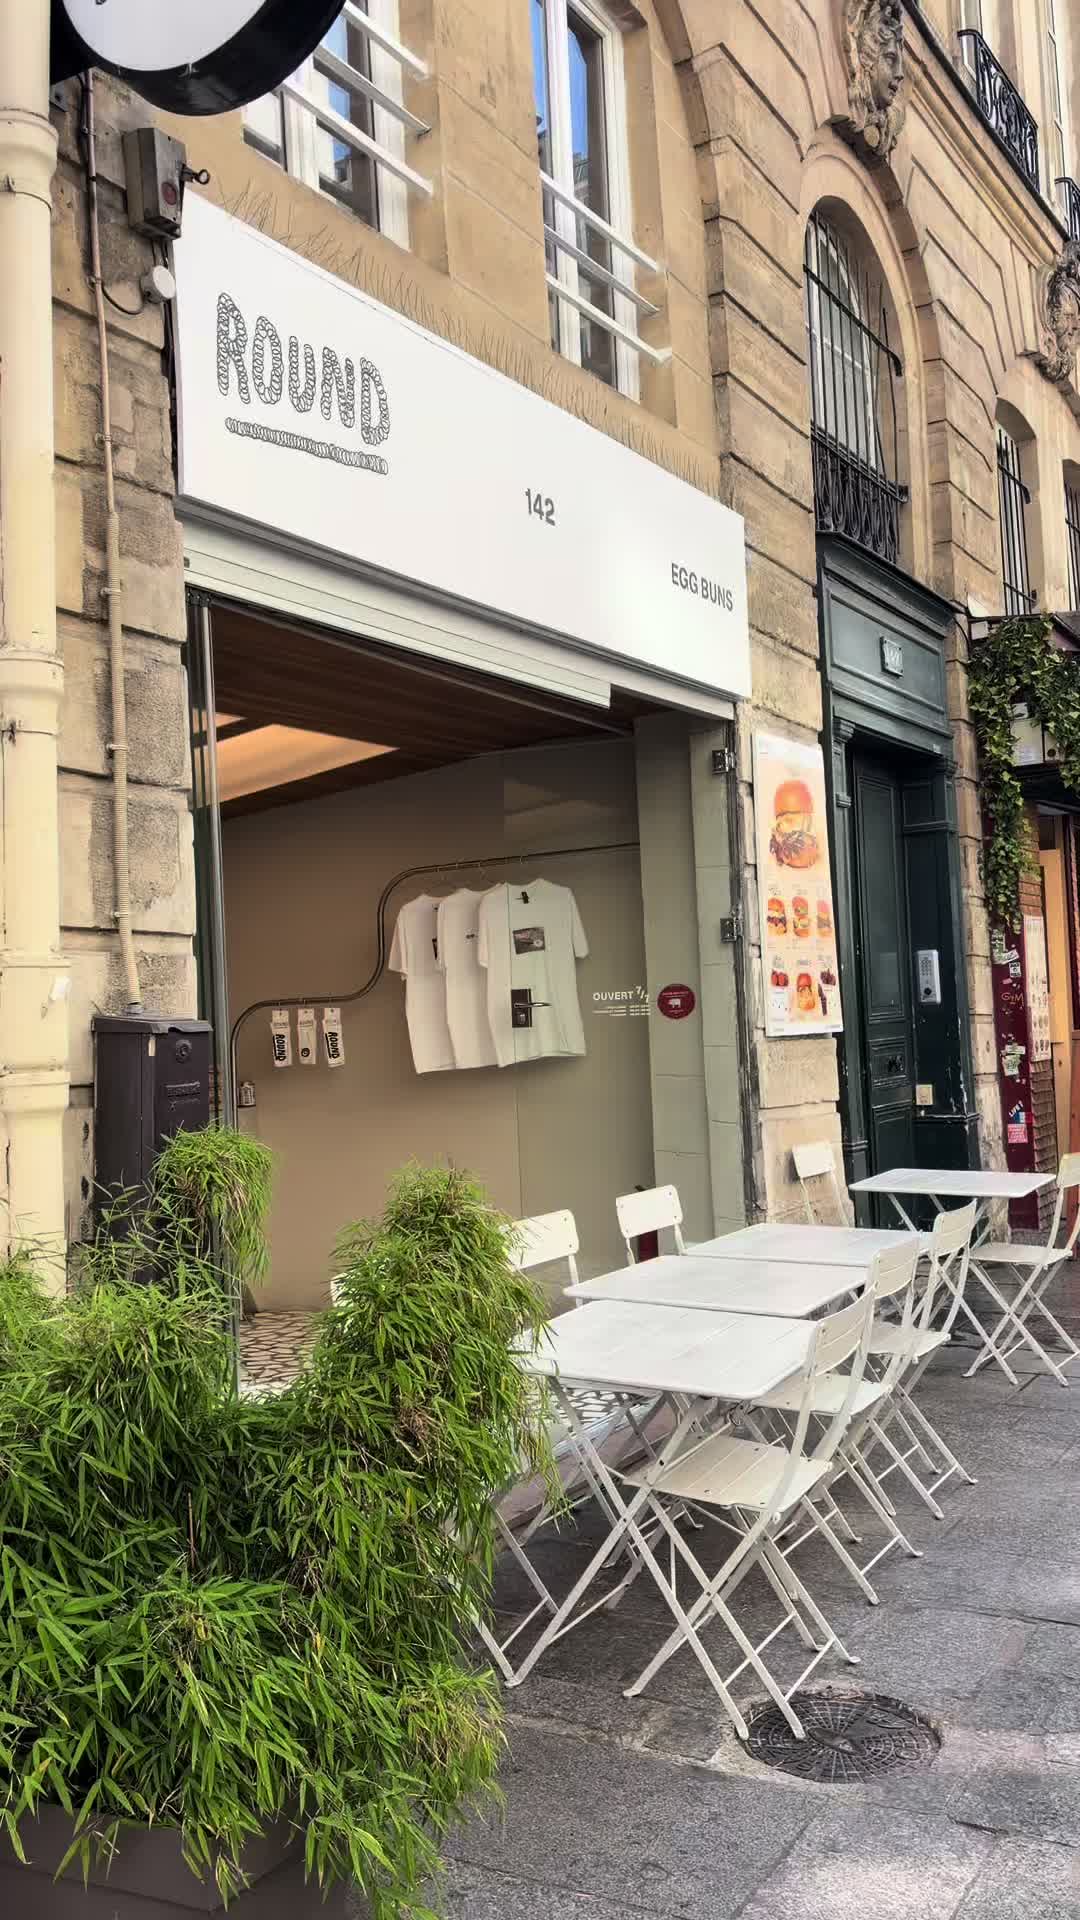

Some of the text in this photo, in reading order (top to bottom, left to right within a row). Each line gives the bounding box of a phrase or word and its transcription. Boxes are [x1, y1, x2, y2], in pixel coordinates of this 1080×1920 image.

[217, 292, 390, 446] ROUND
[525, 487, 556, 526] 142
[671, 562, 733, 613] EGG BUNS
[592, 991, 634, 1001] OUVERT
[275, 1033, 287, 1062] ROUND
[327, 1031, 340, 1059] ROUND
